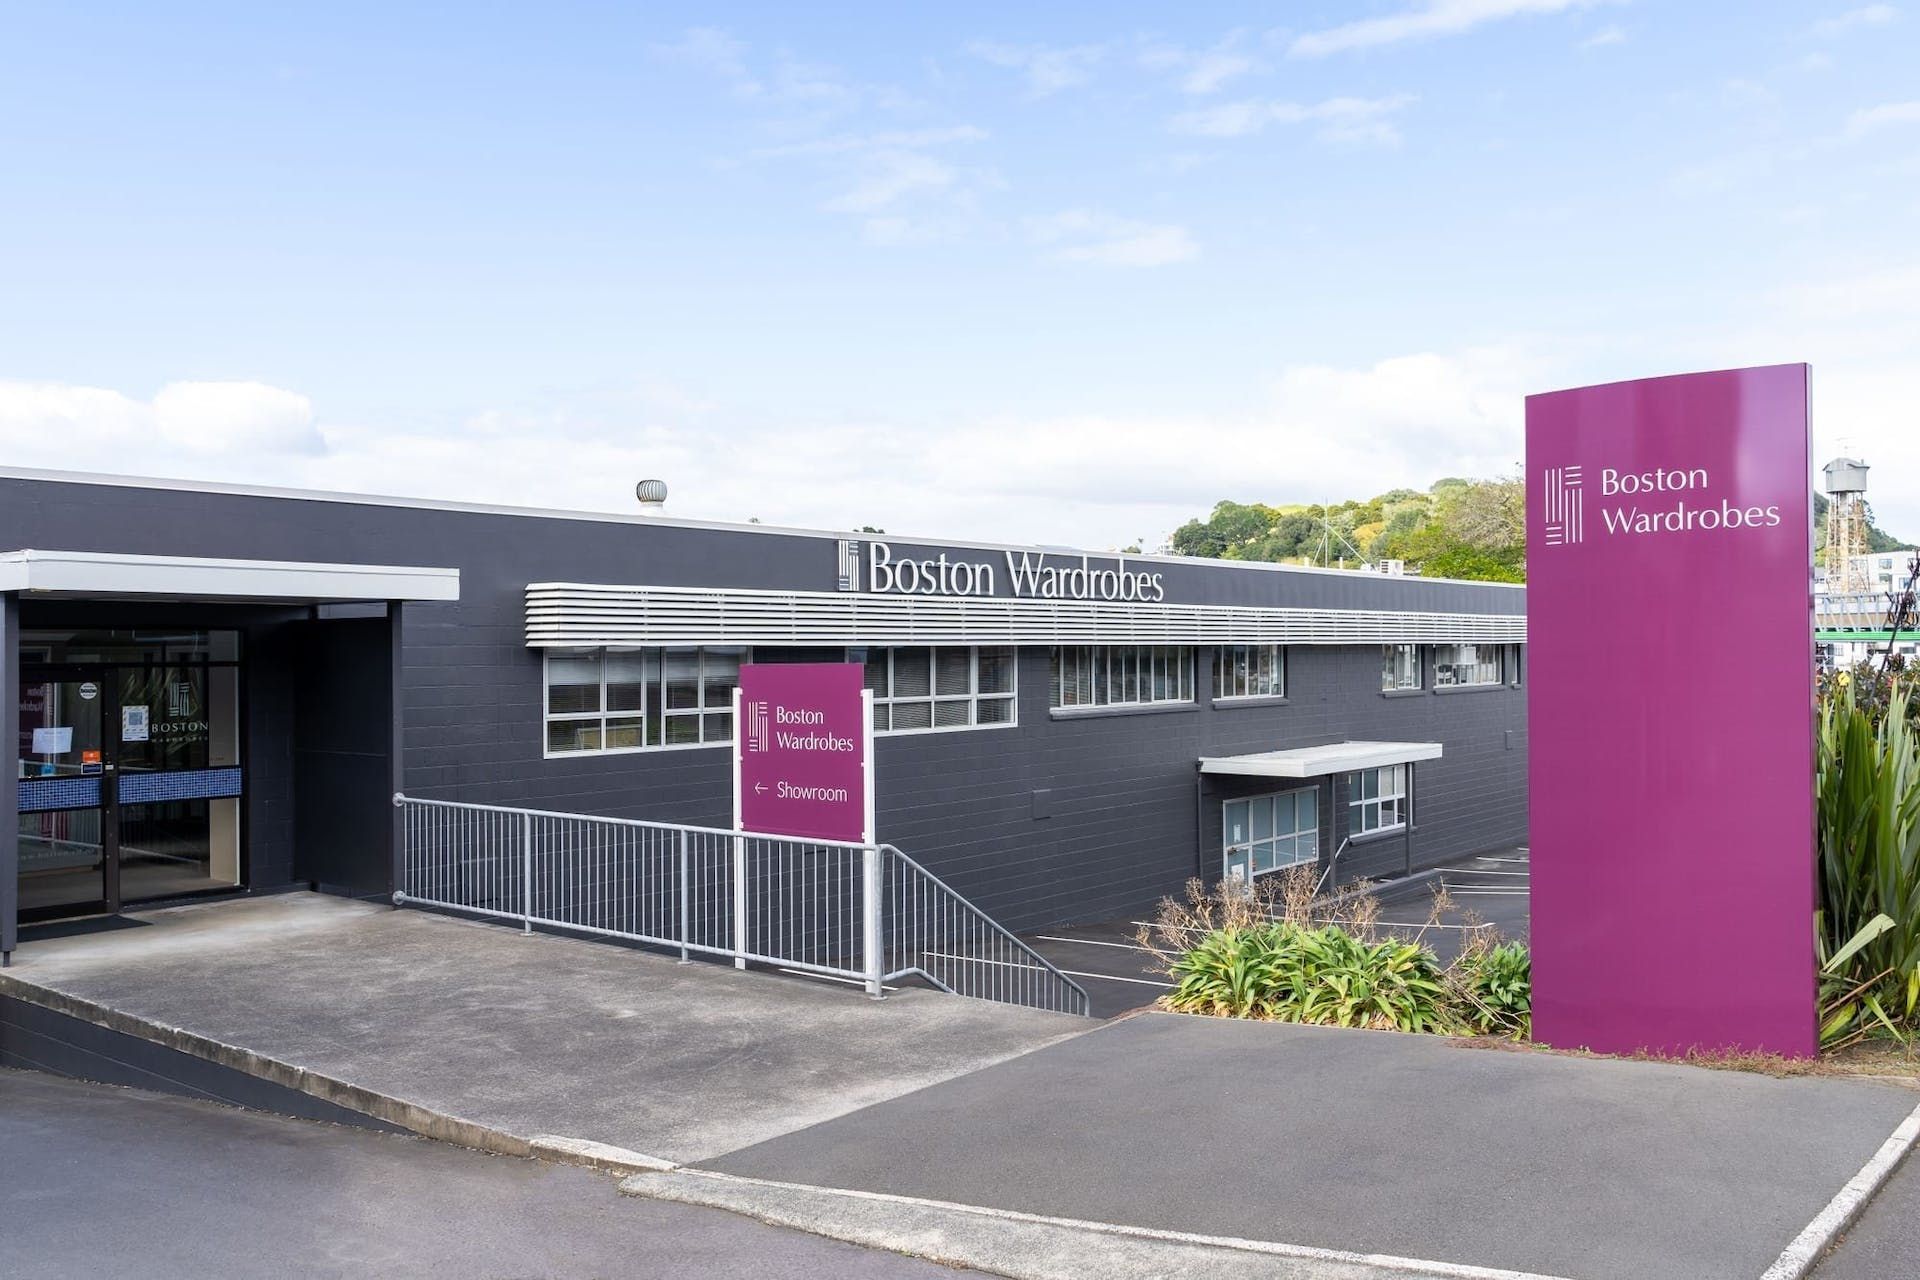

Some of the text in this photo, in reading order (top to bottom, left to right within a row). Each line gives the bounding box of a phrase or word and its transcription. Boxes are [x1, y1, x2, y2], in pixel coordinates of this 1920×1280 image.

[1602, 468, 1708, 496] Boston
[1602, 499, 1781, 535] Wardrobes
[870, 541, 1164, 602] Boston Wardrobes
[776, 706, 824, 725] Boston
[151, 722, 208, 733] BOSTON
[776, 731, 854, 752] Wardrobes
[777, 781, 848, 802] Showroom
